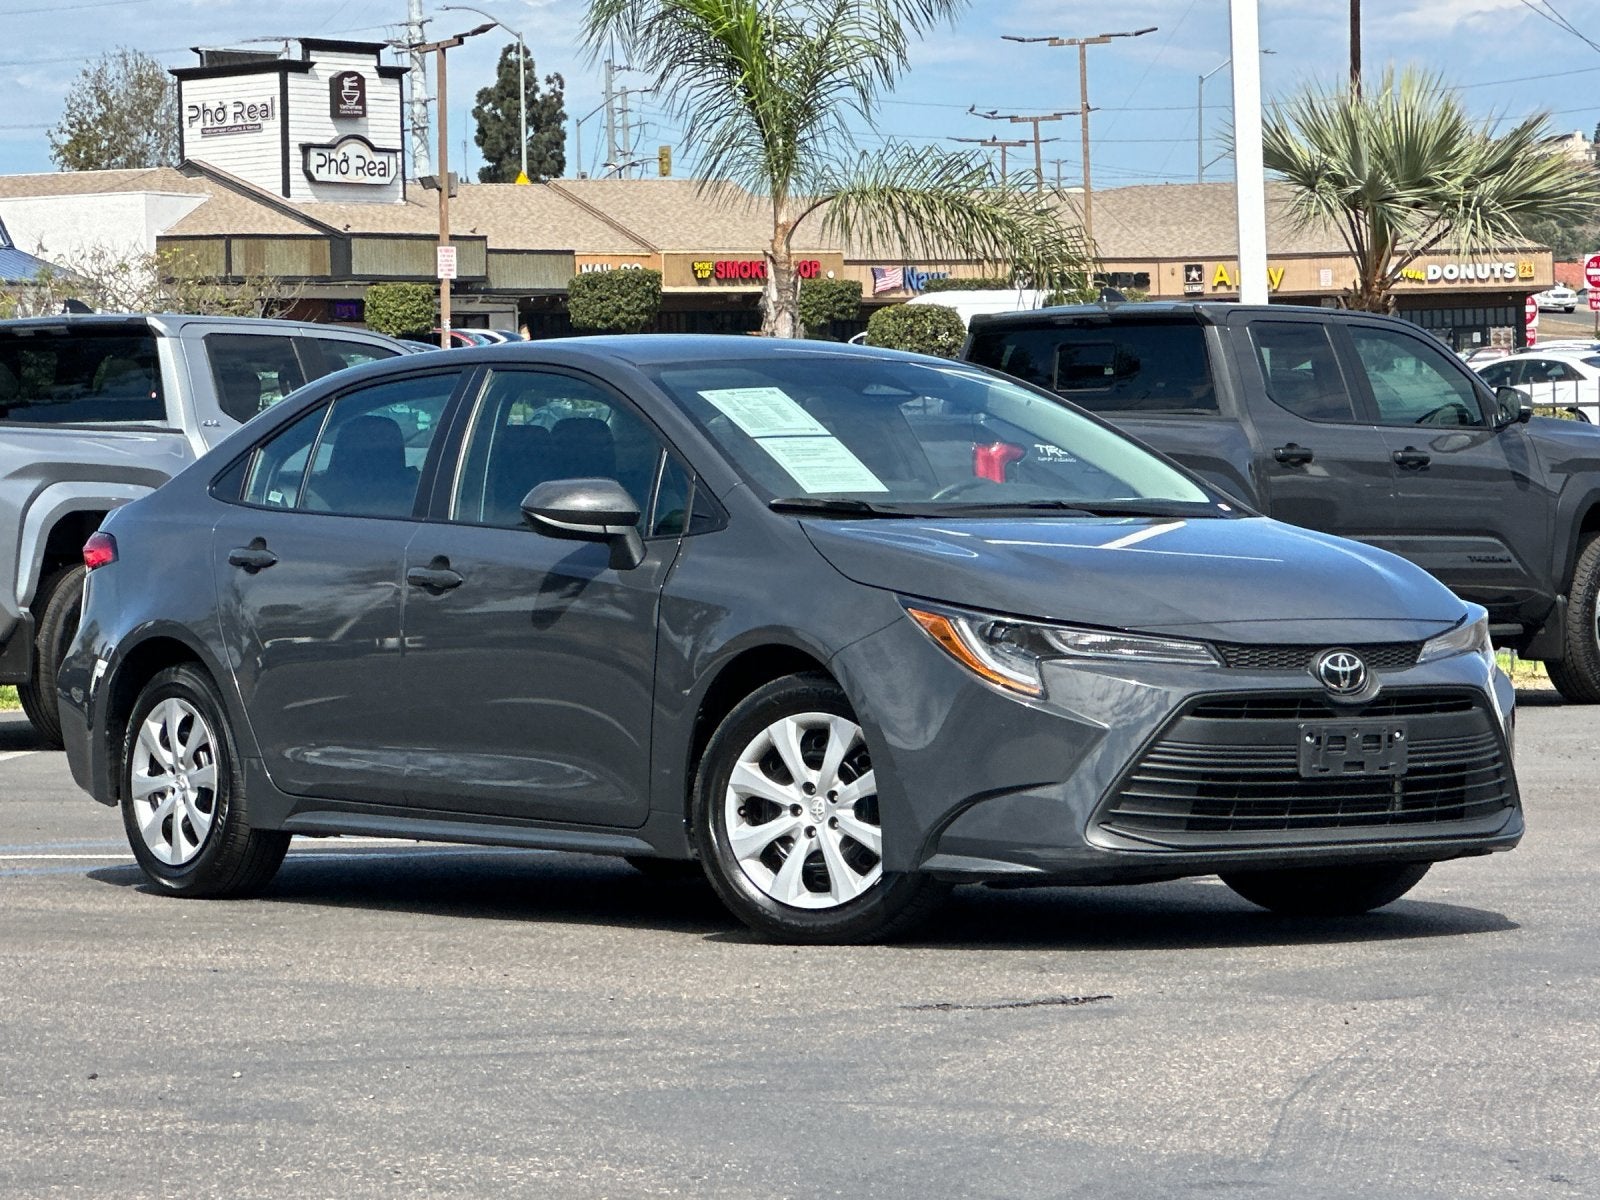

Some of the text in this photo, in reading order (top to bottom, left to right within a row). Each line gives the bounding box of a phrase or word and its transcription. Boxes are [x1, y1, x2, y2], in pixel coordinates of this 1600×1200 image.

[233, 95, 275, 124] Real
[355, 155, 391, 178] Real
[693, 261, 714, 271] SMOKE
[1427, 262, 1517, 280] DONUTS
[1521, 265, 1533, 274] 24
